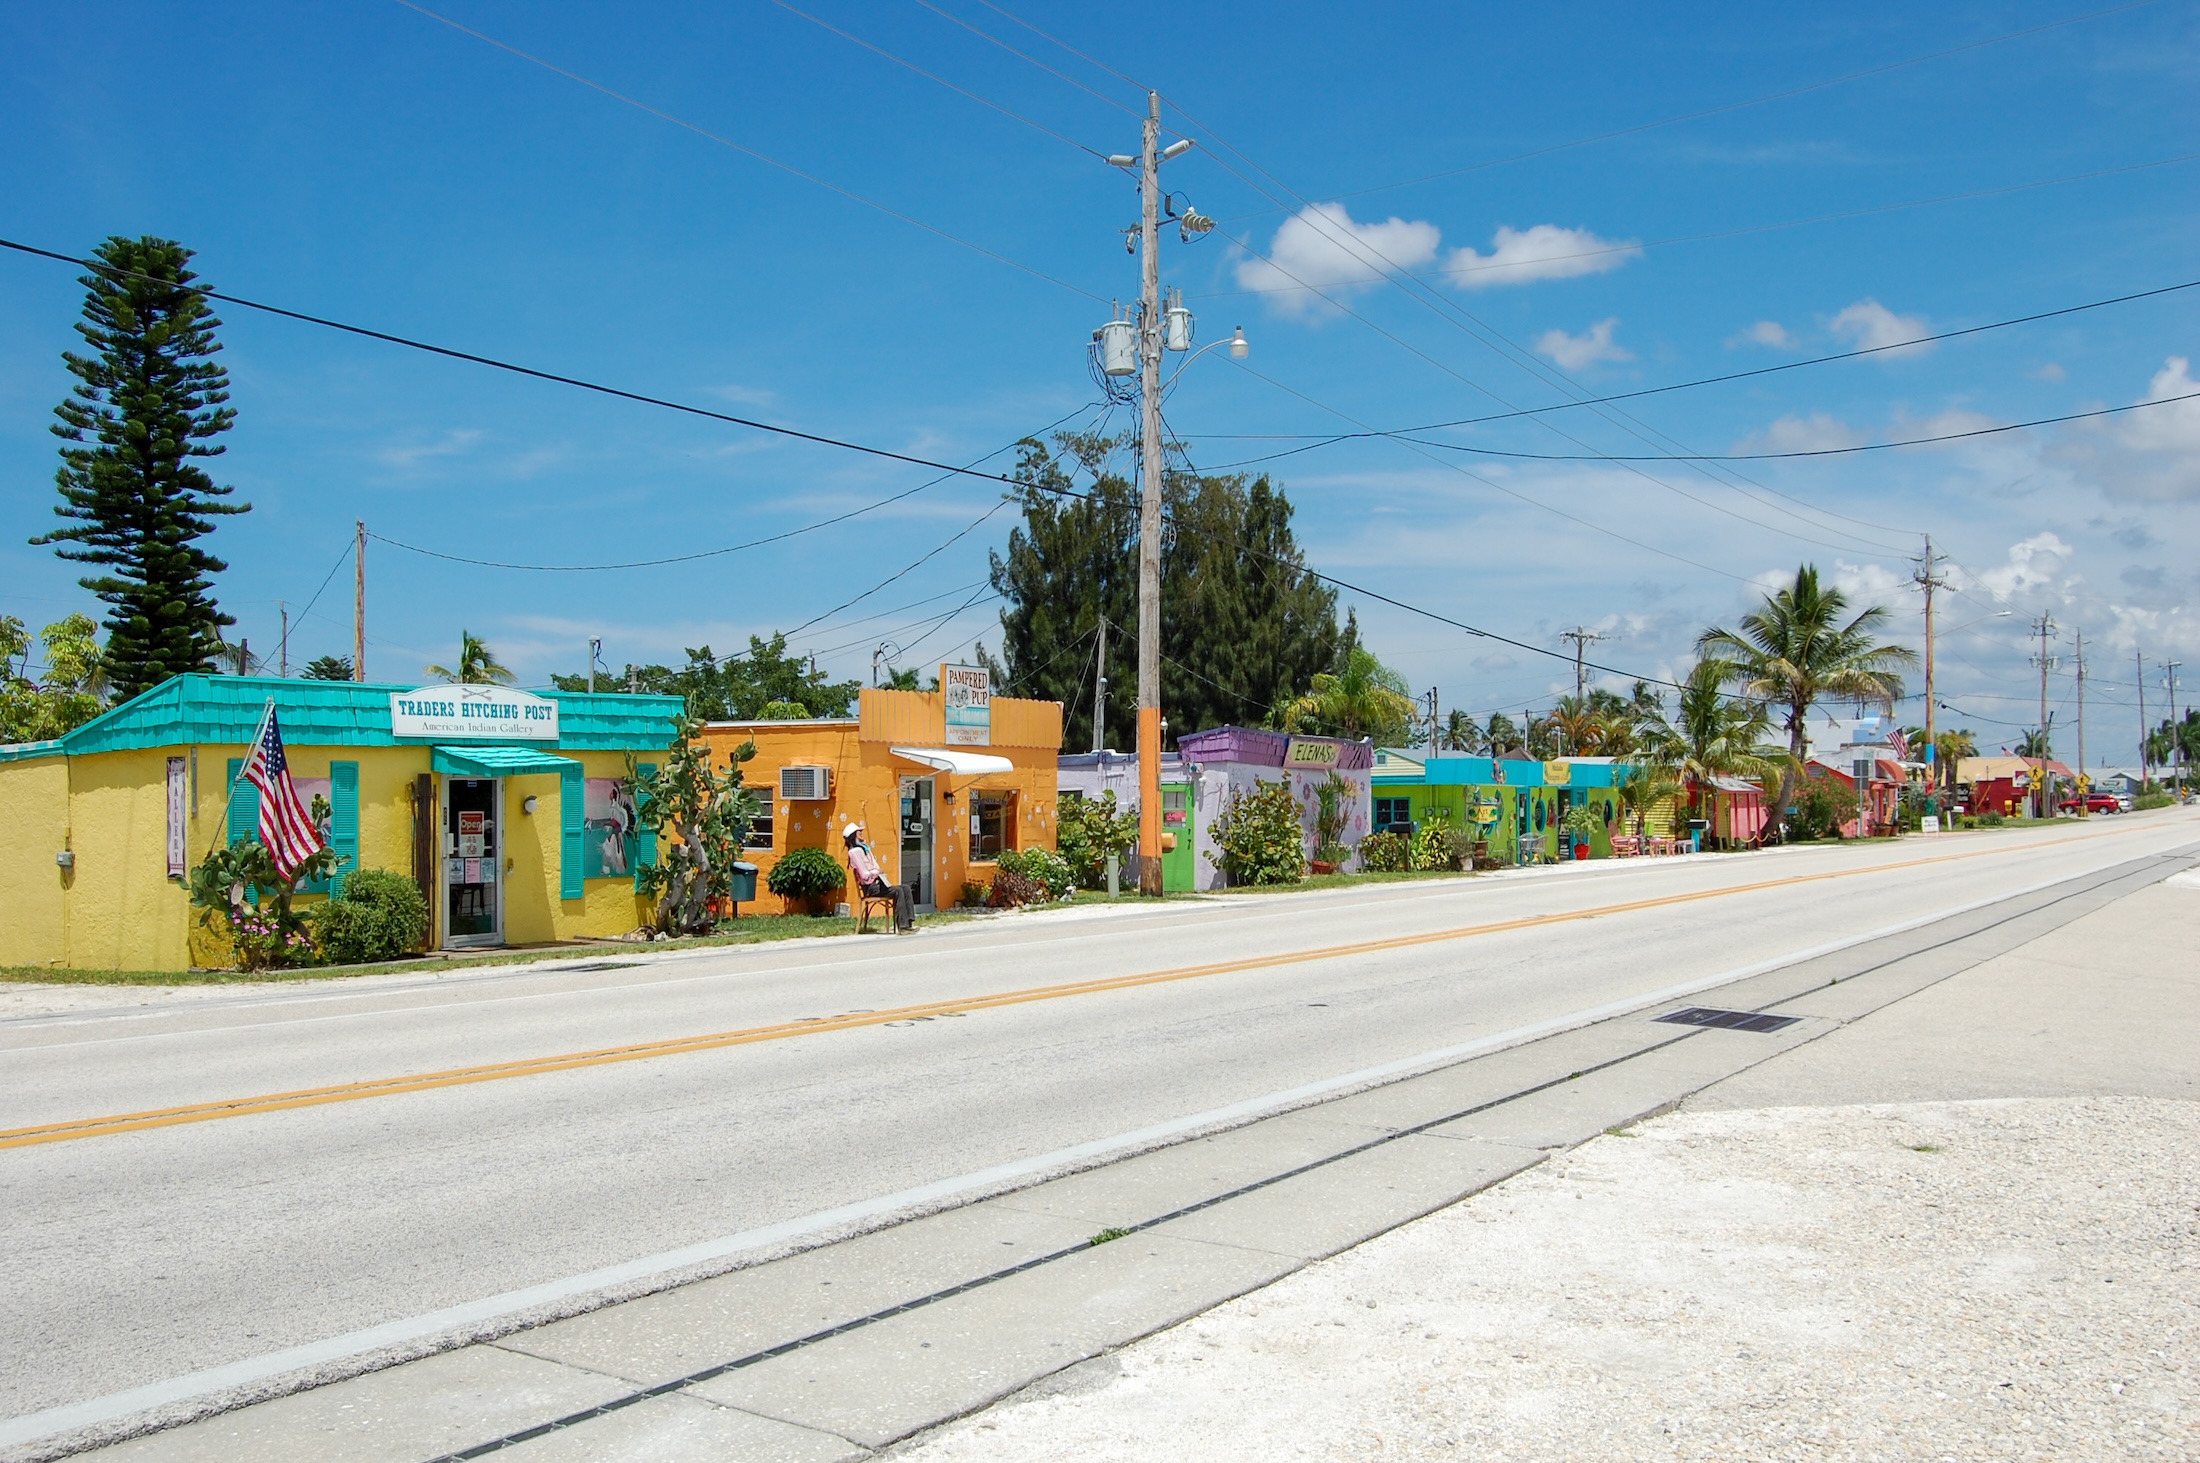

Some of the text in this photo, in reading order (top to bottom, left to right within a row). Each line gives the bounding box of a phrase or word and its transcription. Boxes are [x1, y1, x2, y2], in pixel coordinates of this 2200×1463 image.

[949, 670, 987, 689] PAMPERED
[971, 690, 988, 705] PUP
[399, 700, 553, 720] TRADERS HITCHING POST
[422, 721, 534, 736] American Indian Gallery
[948, 728, 988, 736] APPOINTMENT
[461, 819, 482, 831] Open
